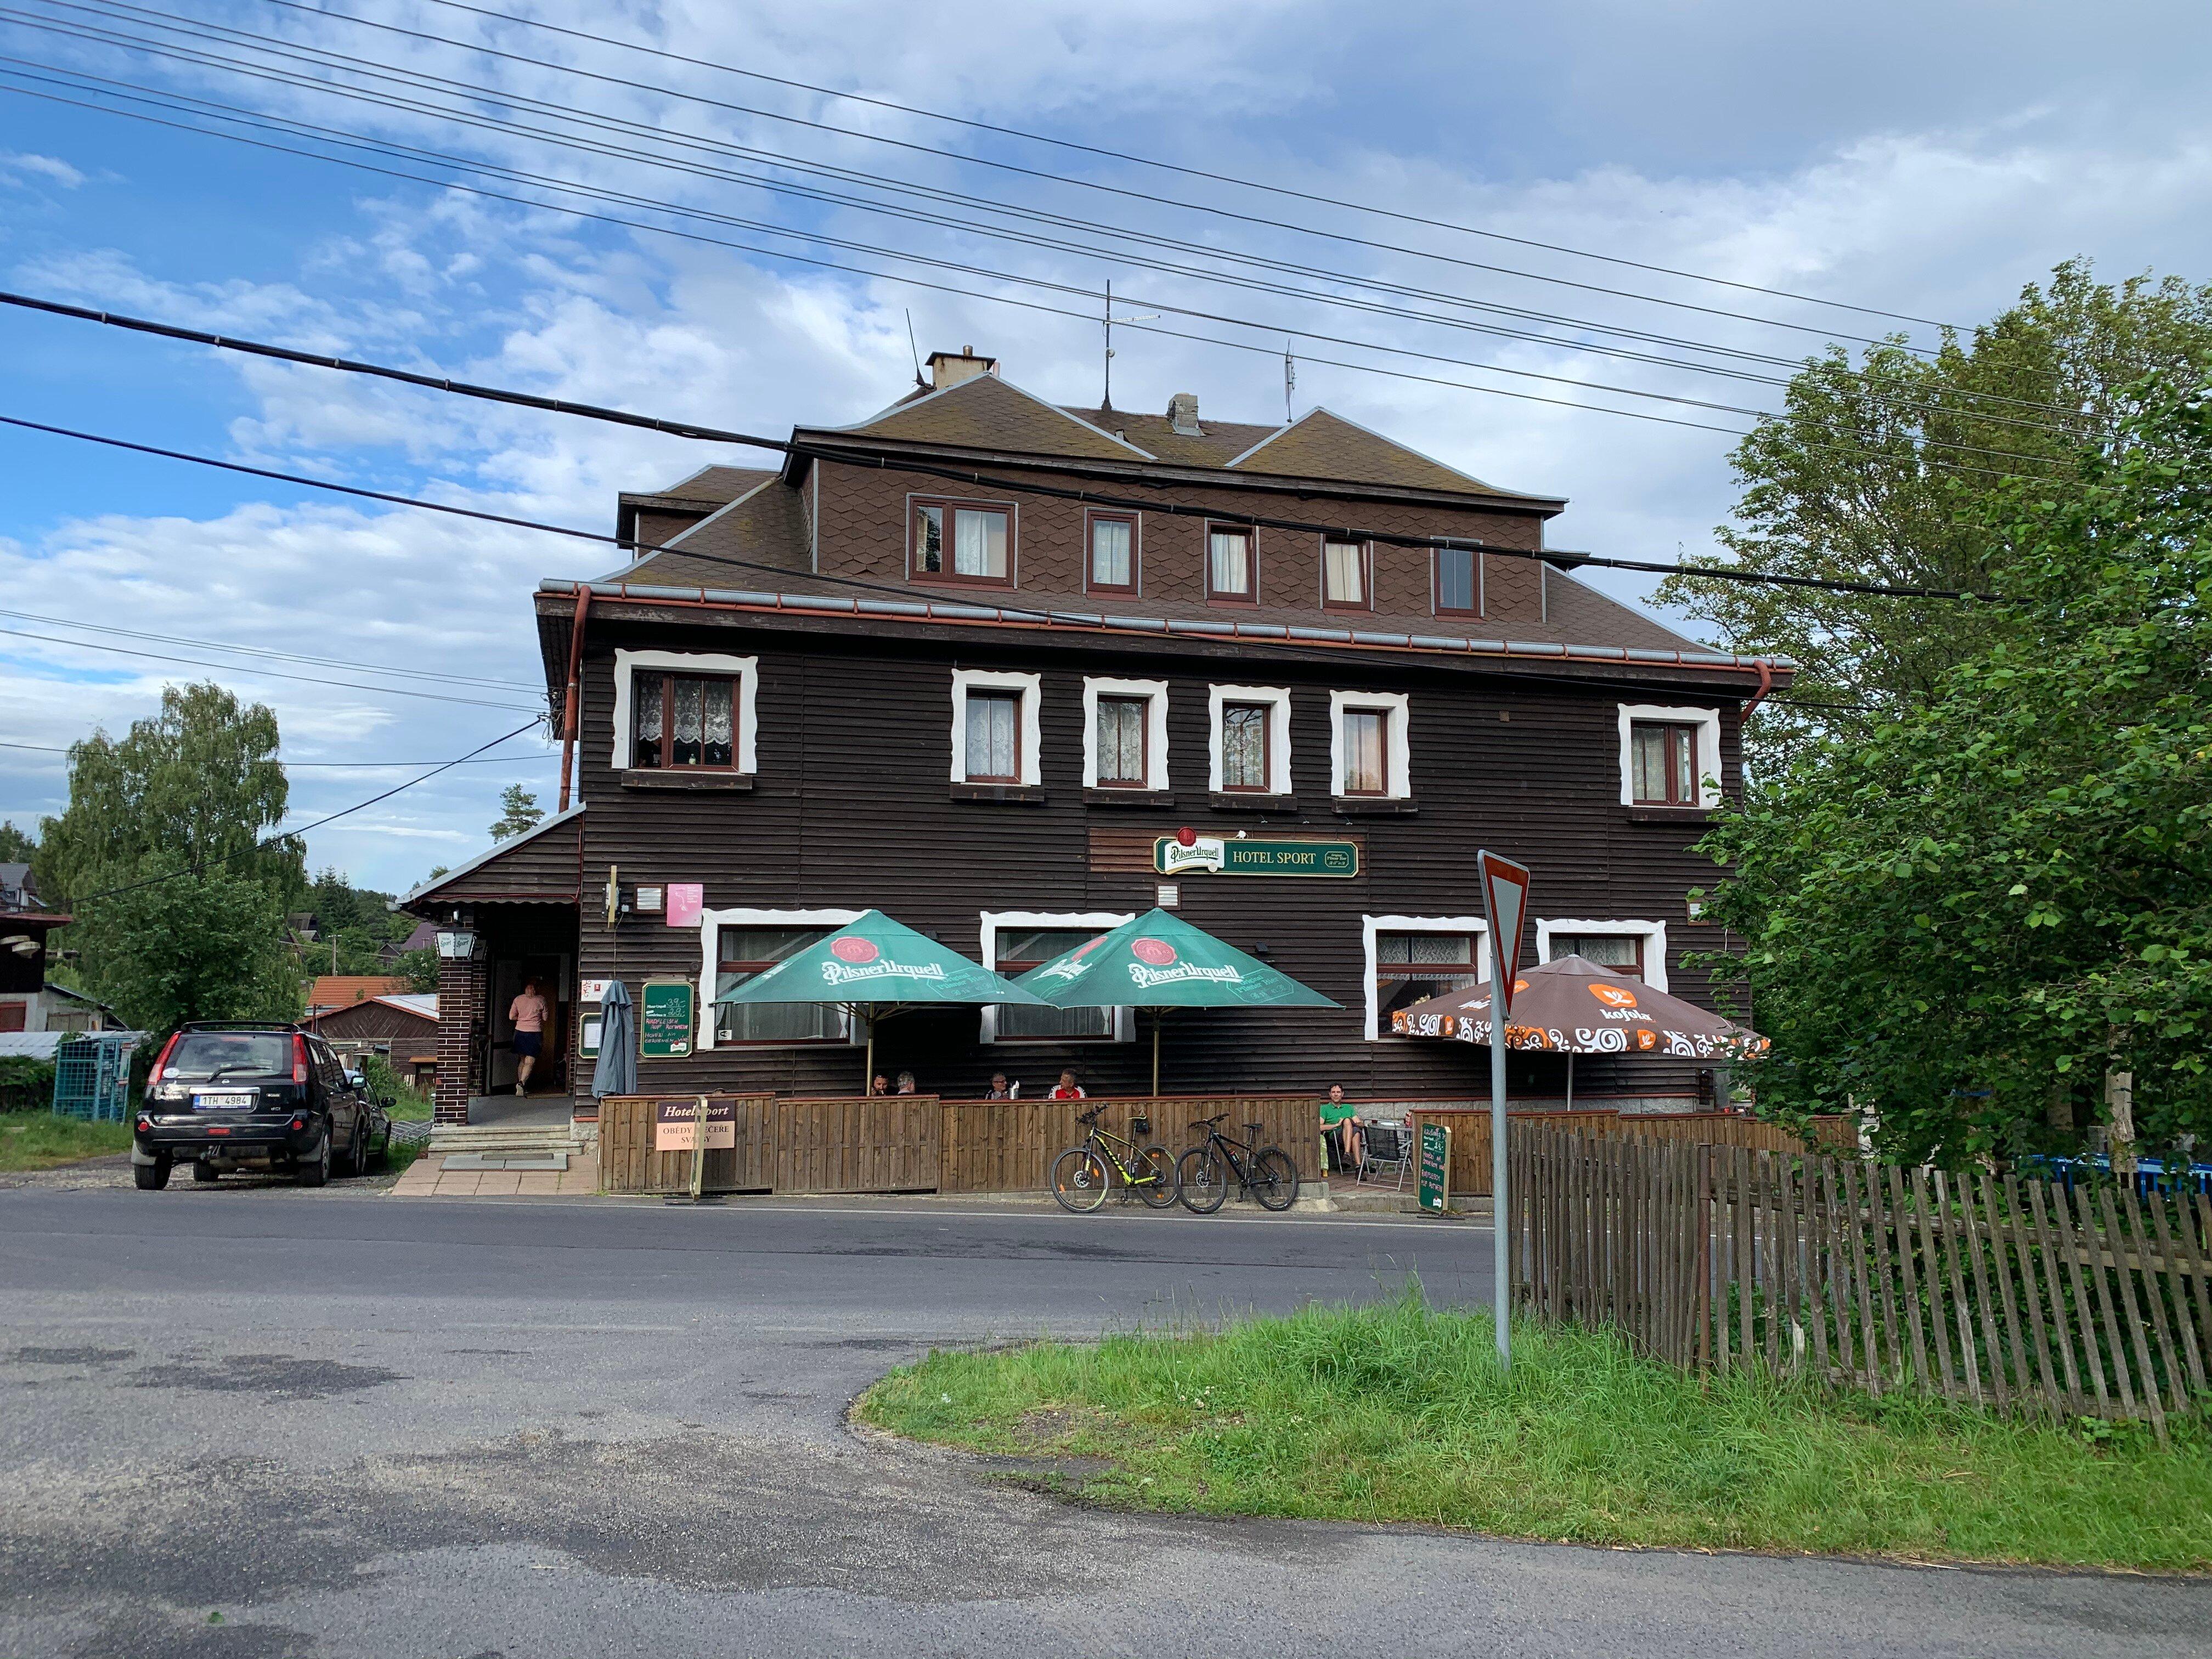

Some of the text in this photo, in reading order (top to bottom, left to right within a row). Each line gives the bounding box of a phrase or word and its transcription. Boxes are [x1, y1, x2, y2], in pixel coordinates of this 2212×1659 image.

[1233, 851, 1317, 864] HOTEL SPORT
[1599, 1008, 1652, 1022] kofola
[202, 1096, 247, 1105] 1TH 4984
[664, 1105, 696, 1117] Hotel
